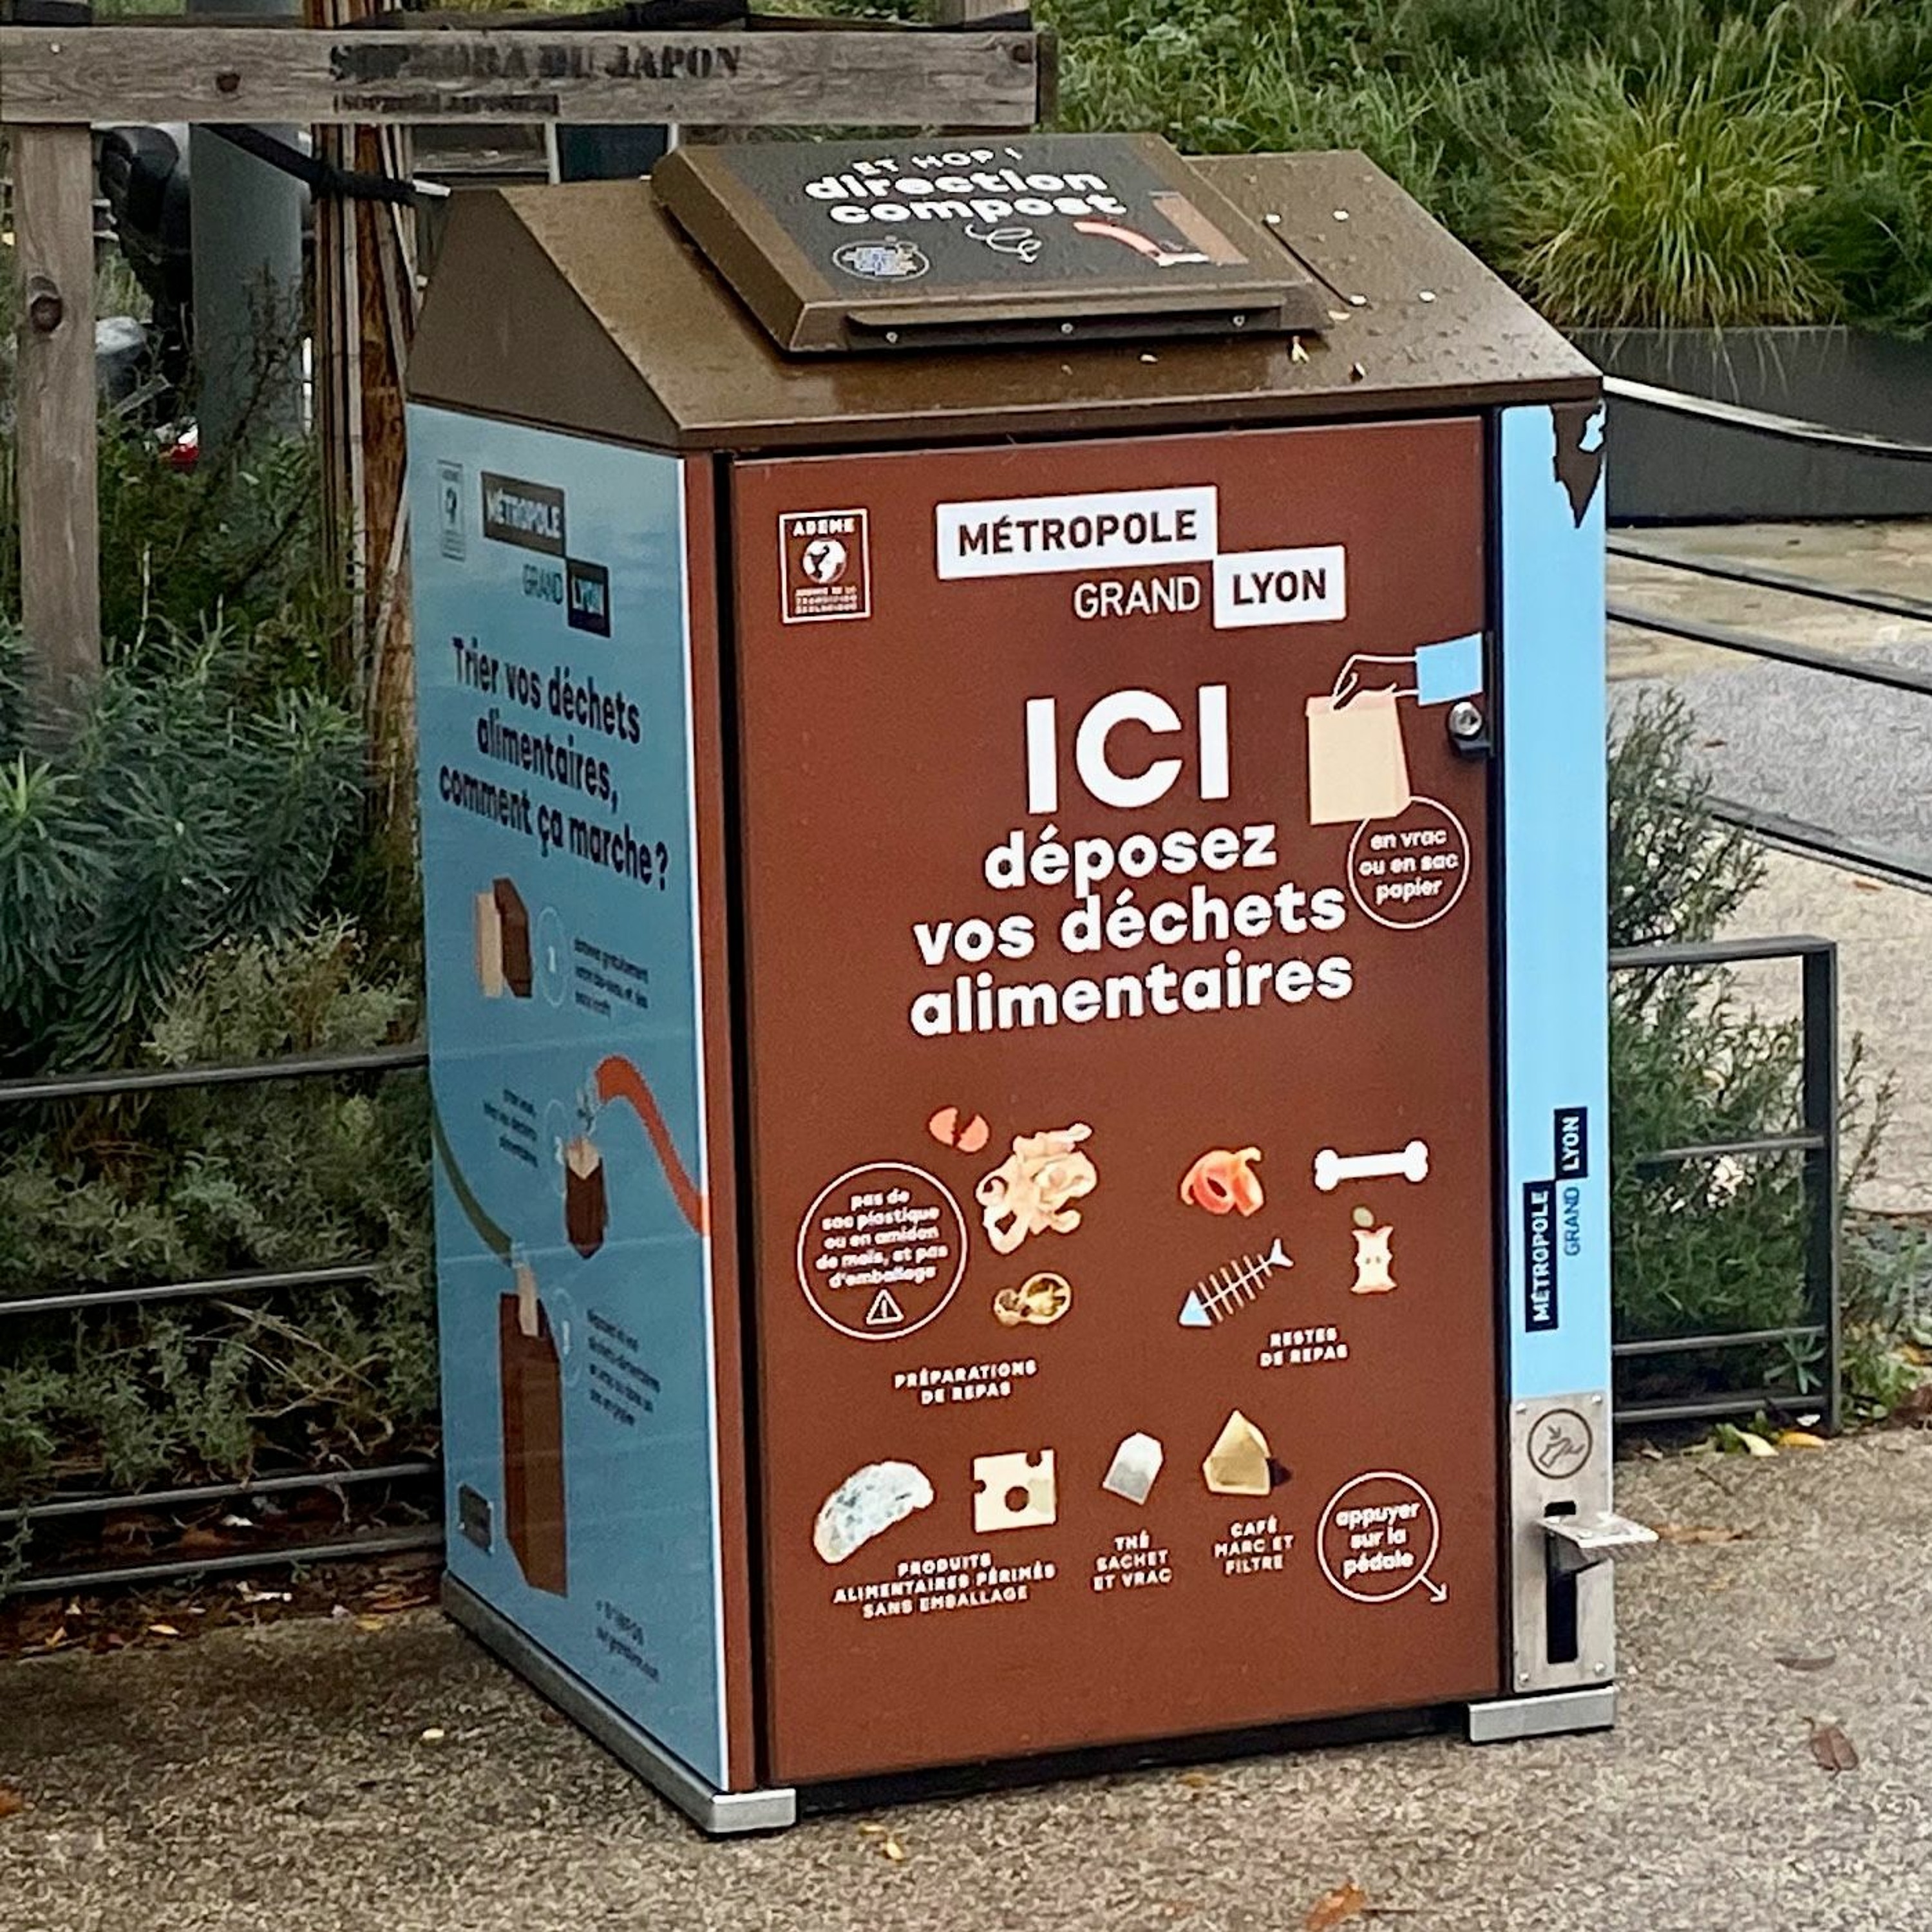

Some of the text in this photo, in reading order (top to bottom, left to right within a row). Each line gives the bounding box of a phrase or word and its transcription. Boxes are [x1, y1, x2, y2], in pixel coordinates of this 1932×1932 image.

[605, 44, 741, 79] JAPON
[852, 159, 900, 176] ET
[911, 150, 994, 169] HOP
[805, 168, 1108, 200] direction
[830, 194, 1128, 223] compost
[958, 509, 1198, 557] MÉTROPOLE
[1074, 568, 1327, 620] GRAND LYON
[453, 638, 641, 744] Trier vos déchets
[478, 708, 618, 815] alimentaires,
[1026, 684, 1229, 815] ICI
[439, 765, 669, 891] comment ça marche ?
[1370, 829, 1447, 850] en vrac
[984, 824, 1278, 900] déposez
[1359, 853, 1459, 876] ou en sac
[1376, 876, 1443, 905] papier
[913, 882, 1347, 966] vos déchets
[910, 948, 1354, 1036] alimentaires
[1561, 1116, 1580, 1171] LYON
[857, 1206, 940, 1231] plastique
[1564, 1186, 1581, 1256] GRAND
[1530, 1190, 1551, 1322] MÉTROPOLE
[1269, 1327, 1338, 1348] RESTES
[1260, 1343, 1349, 1367] DE REPAS
[895, 1359, 1037, 1389] PRÉPARATIONS
[921, 1381, 1012, 1405] DE REPAS
[1231, 1514, 1278, 1538] CAFÉ
[1335, 1502, 1421, 1530] appuyer
[1114, 1529, 1150, 1551] THÉ
[1214, 1535, 1294, 1558] MARC ET
[1350, 1526, 1406, 1549] sur la
[897, 1552, 992, 1577] PRODUITS
[1096, 1549, 1169, 1573] SACHET
[1225, 1554, 1283, 1575] FILTRE
[1343, 1548, 1415, 1580] pédale
[833, 1560, 1056, 1604] ALIMENTAIRES PÉRIMÉS
[1093, 1567, 1173, 1591] ET VRAC
[862, 1585, 1028, 1619] SANS EMBALLAGE
